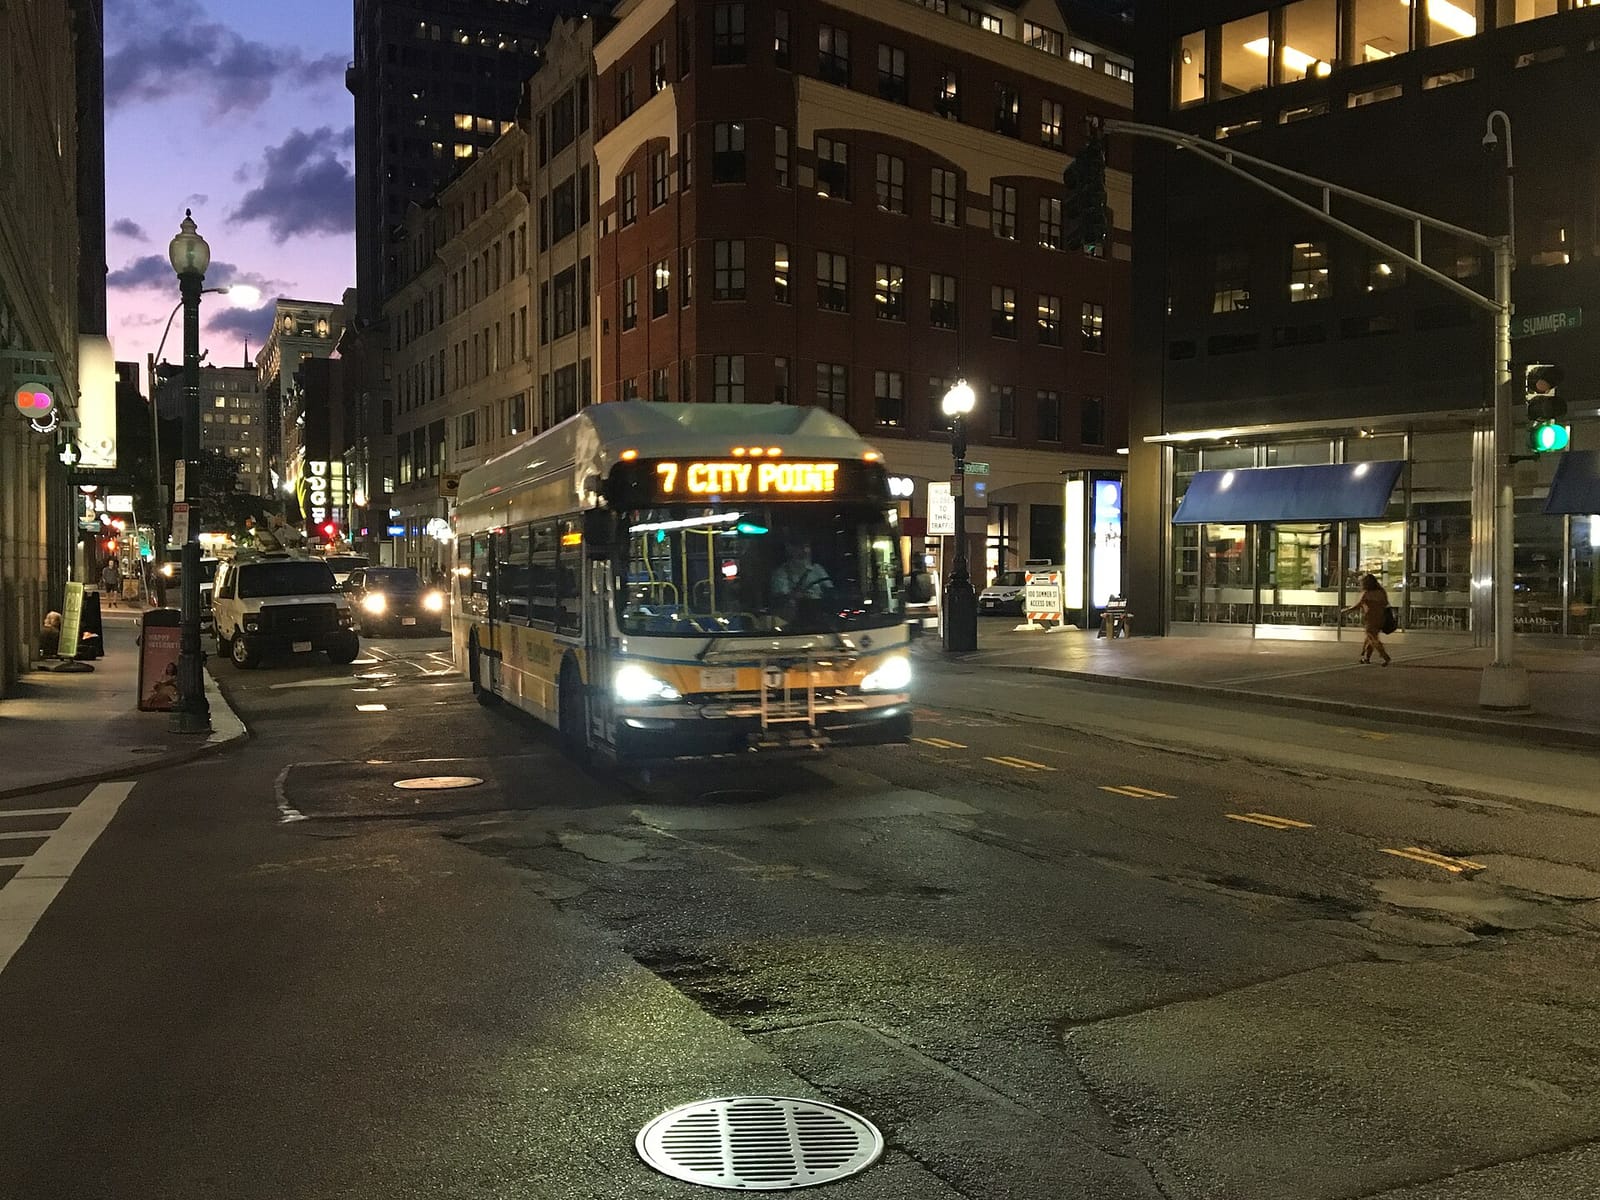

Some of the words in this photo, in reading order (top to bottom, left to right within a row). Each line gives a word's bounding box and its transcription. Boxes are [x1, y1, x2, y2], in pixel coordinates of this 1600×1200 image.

[1522, 312, 1567, 334] SUMMER
[657, 463, 678, 492] 7
[687, 463, 752, 492] CITY
[758, 463, 839, 492] POINT
[1271, 610, 1297, 618] COFFEE
[1513, 616, 1548, 626] SALADS
